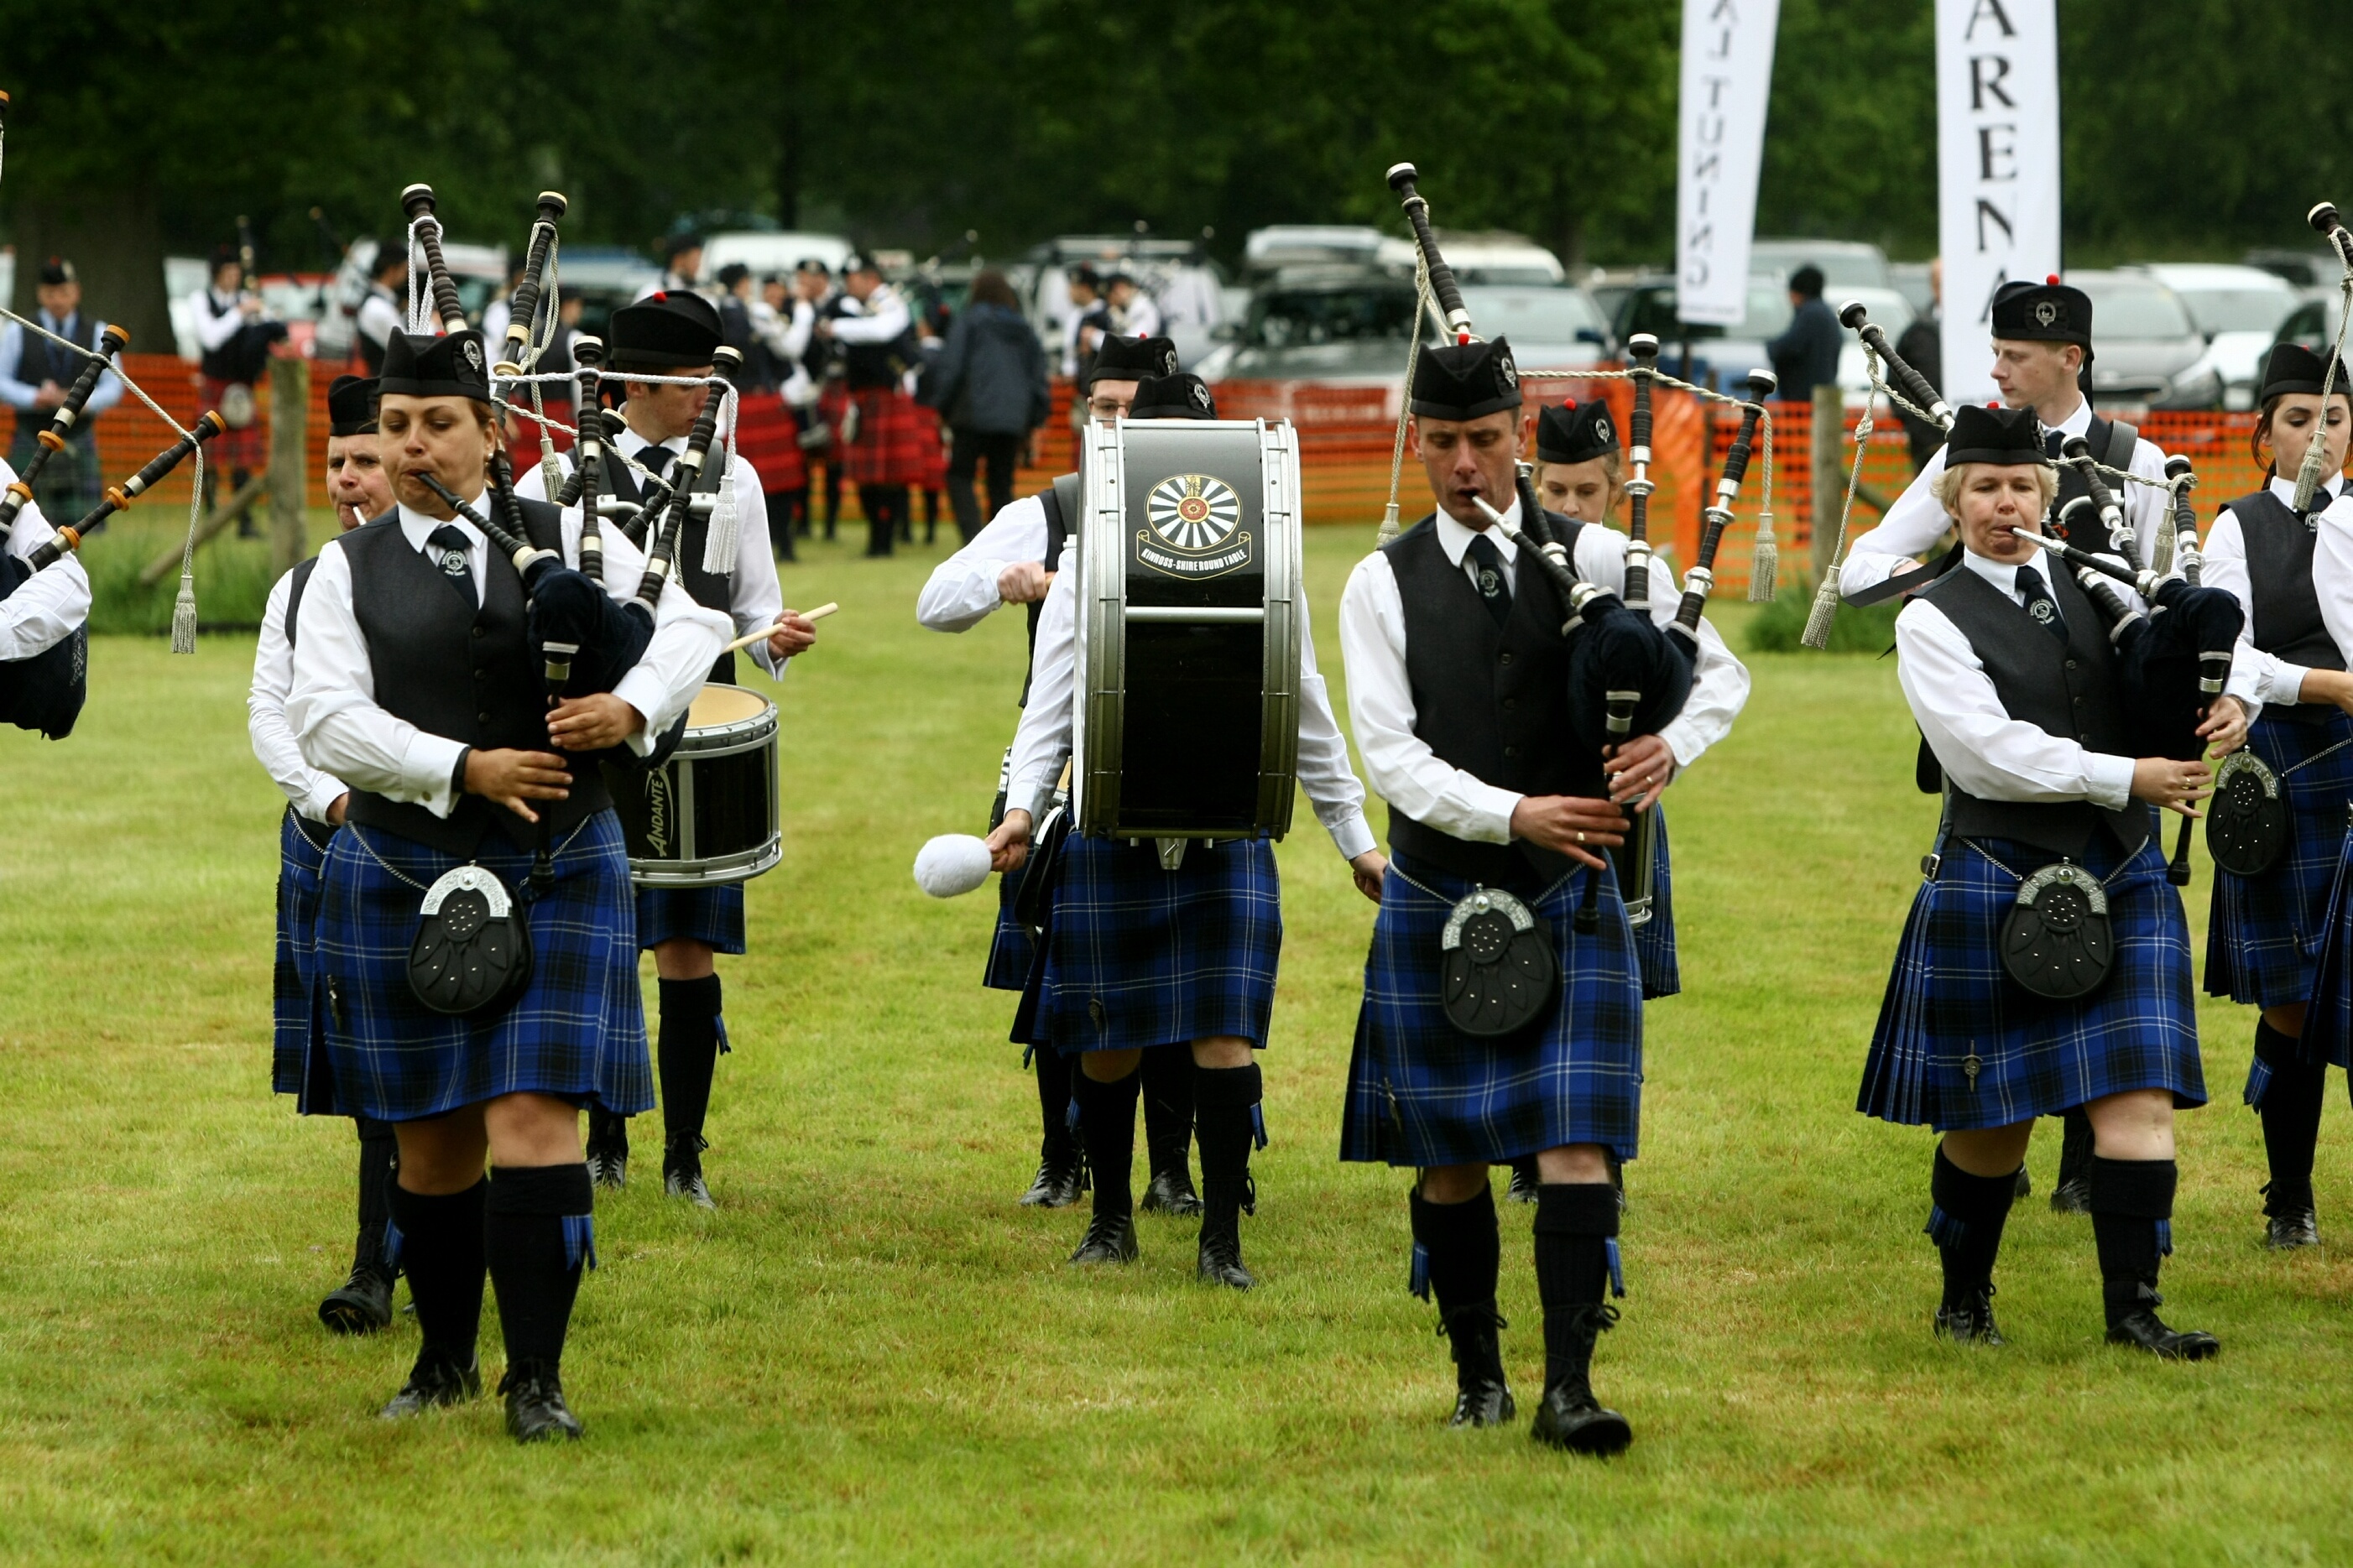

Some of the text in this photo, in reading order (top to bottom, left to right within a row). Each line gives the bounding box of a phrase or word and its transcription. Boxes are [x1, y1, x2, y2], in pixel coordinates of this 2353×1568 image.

[1141, 548, 1247, 571] KINROSS-SHIRE ROUND TABLE
